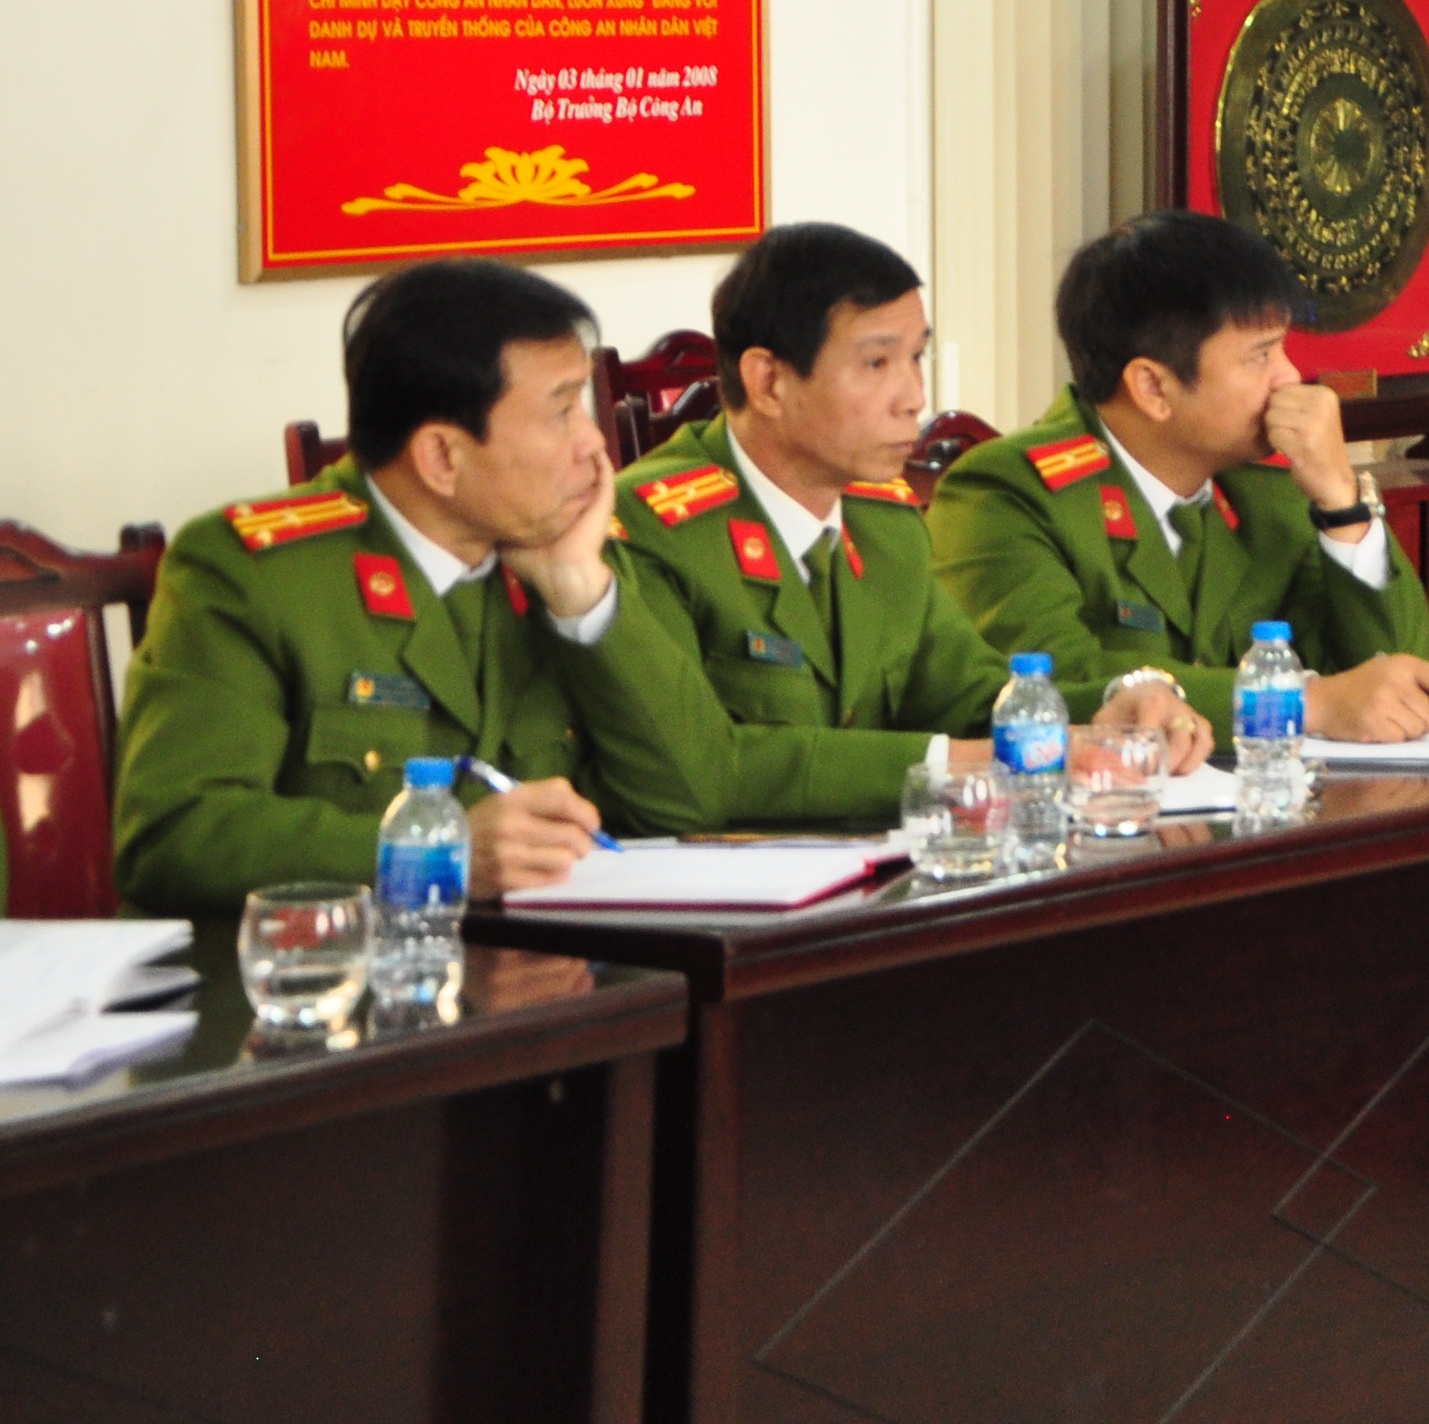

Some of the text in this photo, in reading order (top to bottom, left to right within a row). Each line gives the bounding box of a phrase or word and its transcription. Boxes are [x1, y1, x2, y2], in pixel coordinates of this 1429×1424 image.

[514, 65, 717, 95] Ngày 03 tháng 01 năm 2008
[530, 95, 702, 123] Bộ Trưởng Bộ Công An
